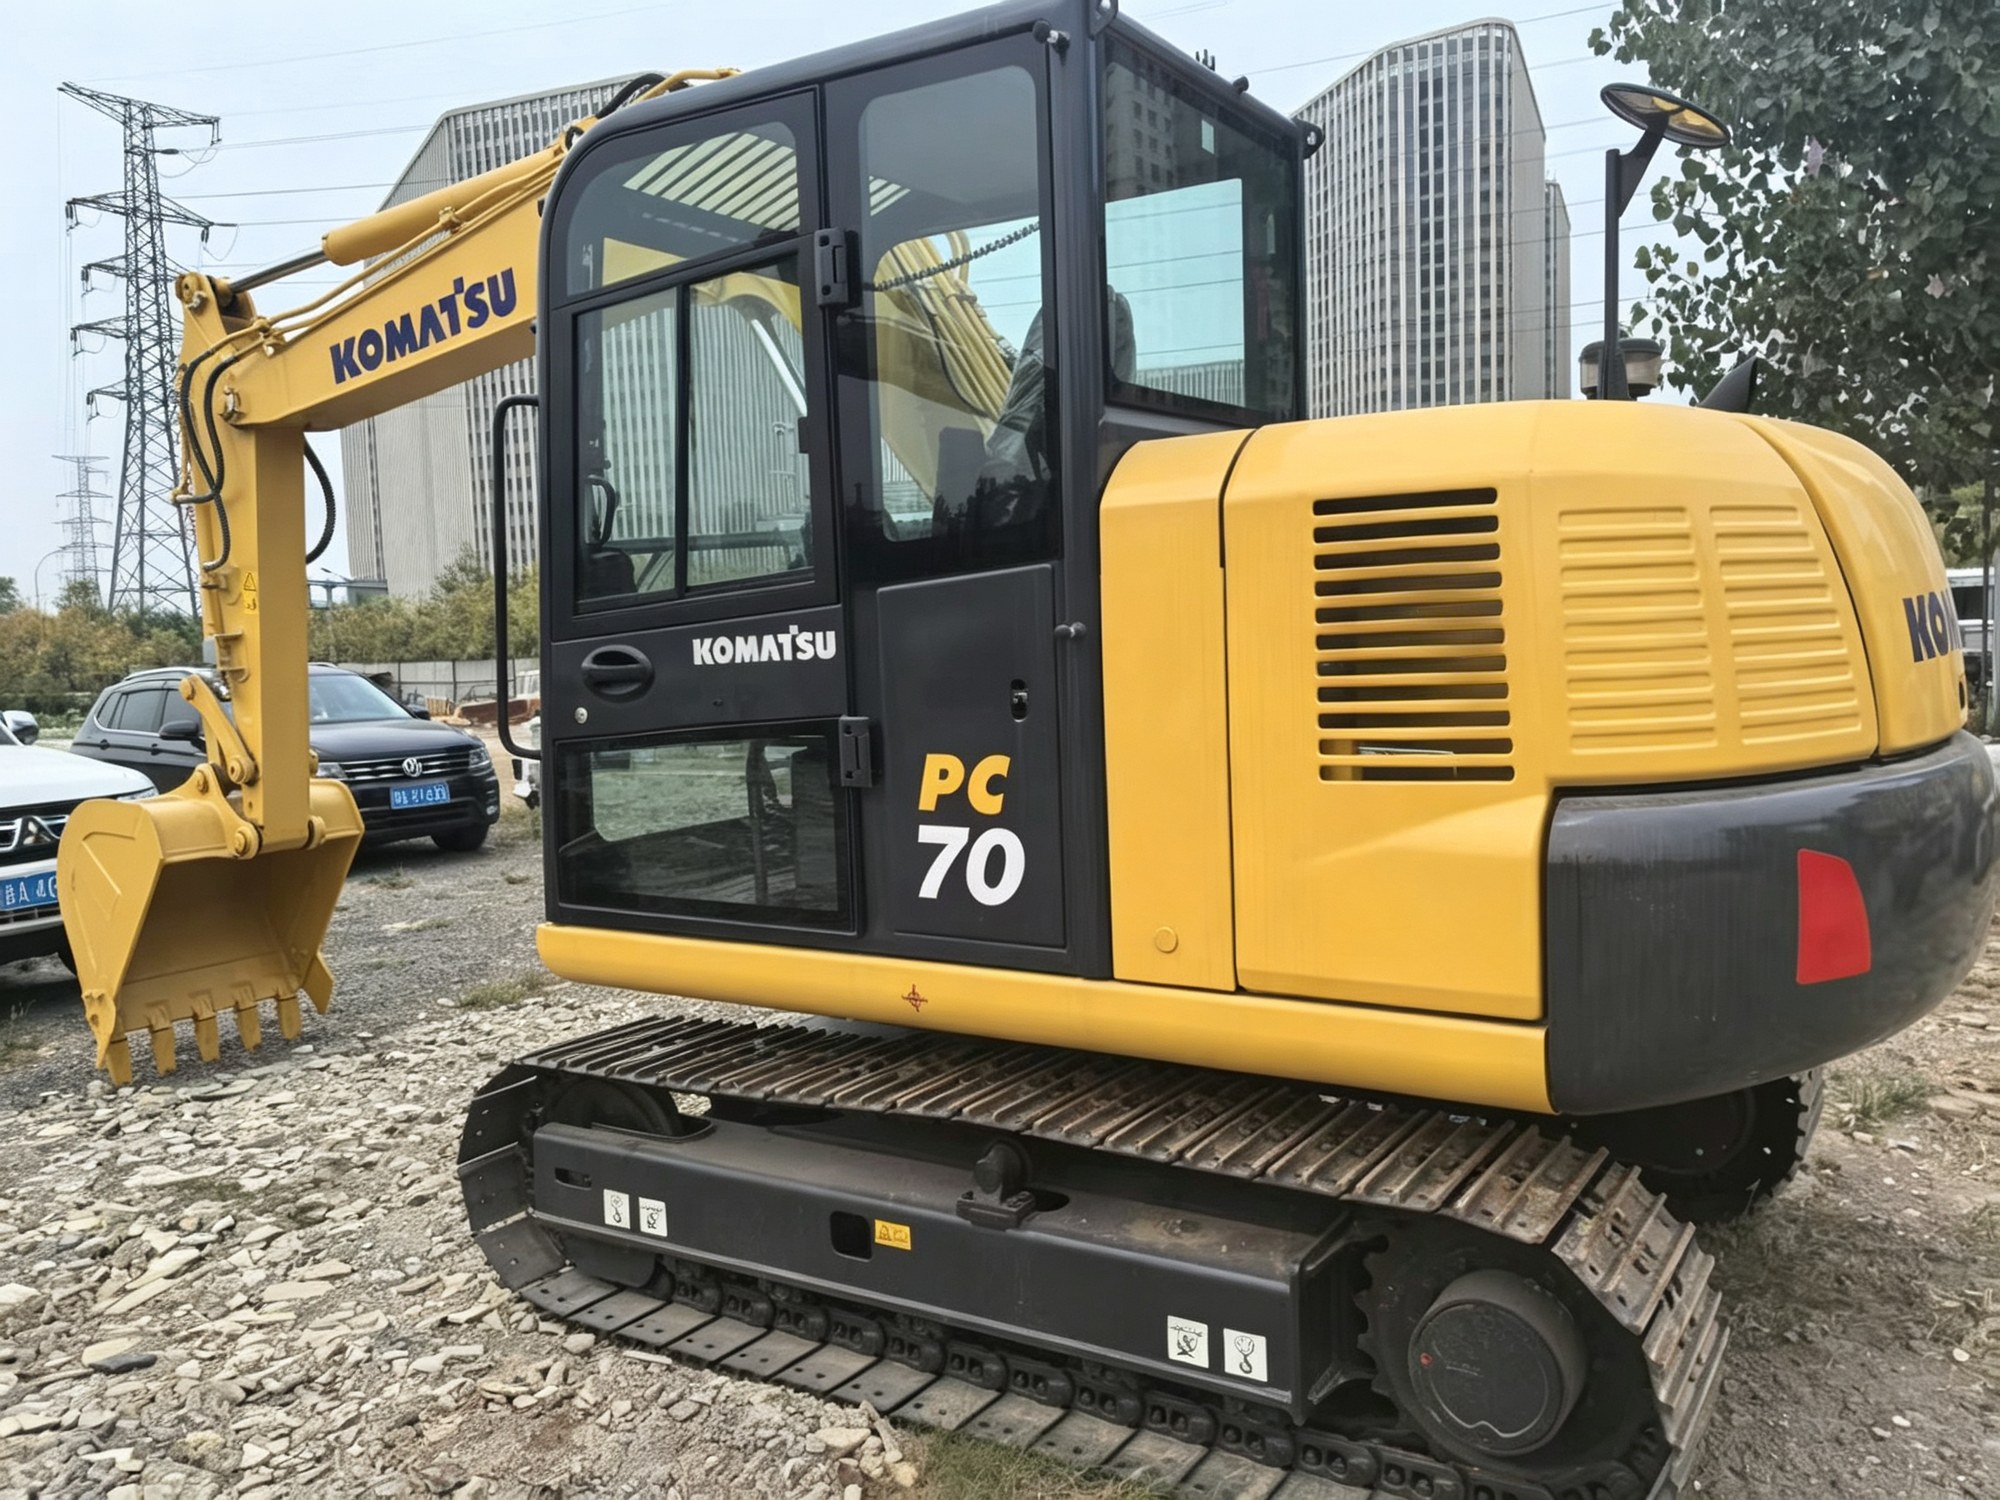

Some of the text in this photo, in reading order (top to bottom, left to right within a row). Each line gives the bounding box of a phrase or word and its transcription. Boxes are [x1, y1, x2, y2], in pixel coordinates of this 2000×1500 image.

[330, 267, 517, 385] KOMATSU
[692, 624, 837, 666] KOMATSU
[918, 753, 1011, 815] PC
[917, 824, 1026, 906] 70
